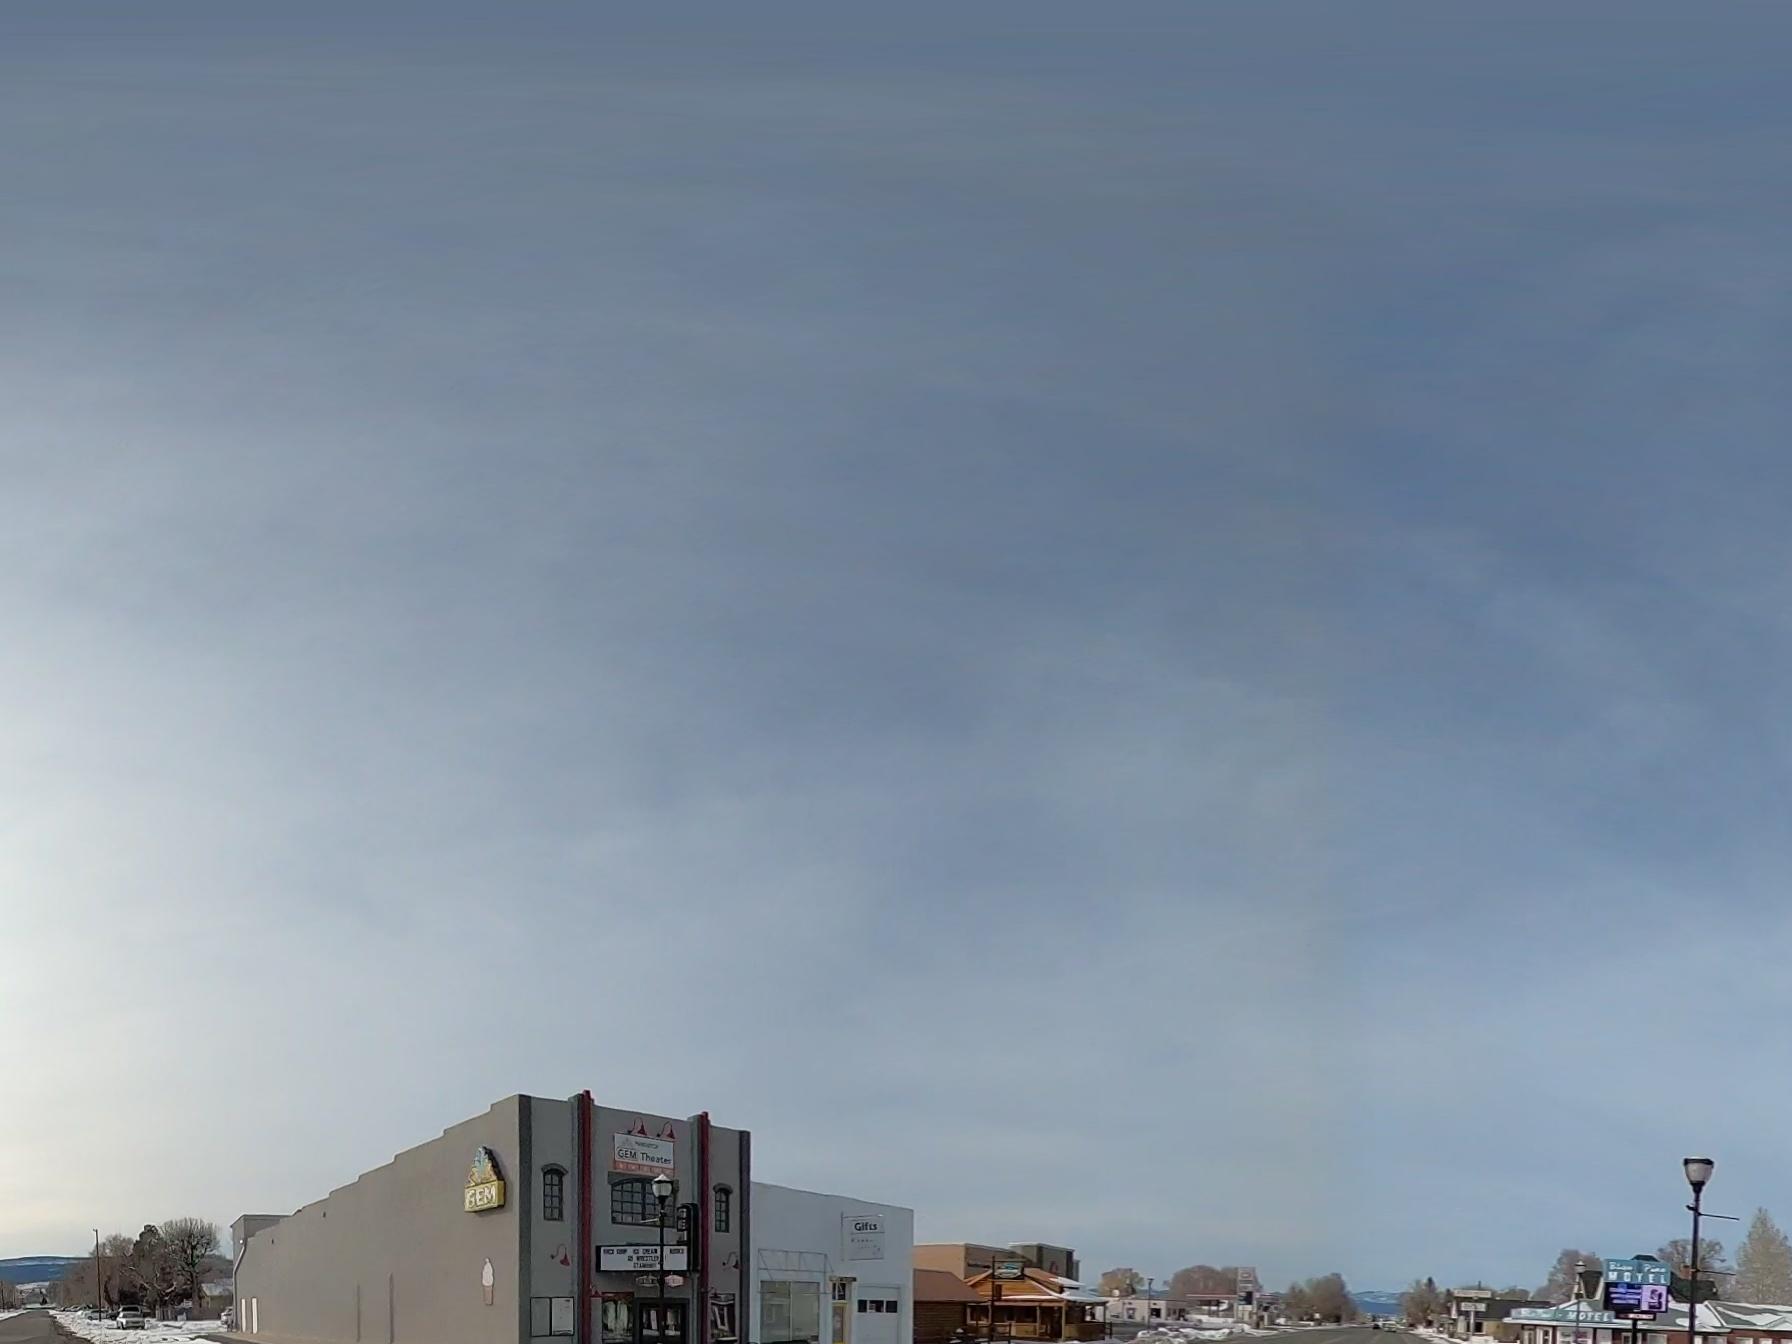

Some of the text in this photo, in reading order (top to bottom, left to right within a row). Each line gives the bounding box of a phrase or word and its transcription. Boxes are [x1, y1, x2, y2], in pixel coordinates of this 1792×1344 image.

[617, 1148, 672, 1165] GEM Theater
[465, 1185, 496, 1208] GEM
[854, 1222, 878, 1231] Gifts
[1608, 1271, 1667, 1284] MOTEL
[1567, 1311, 1611, 1322] MOTEL
